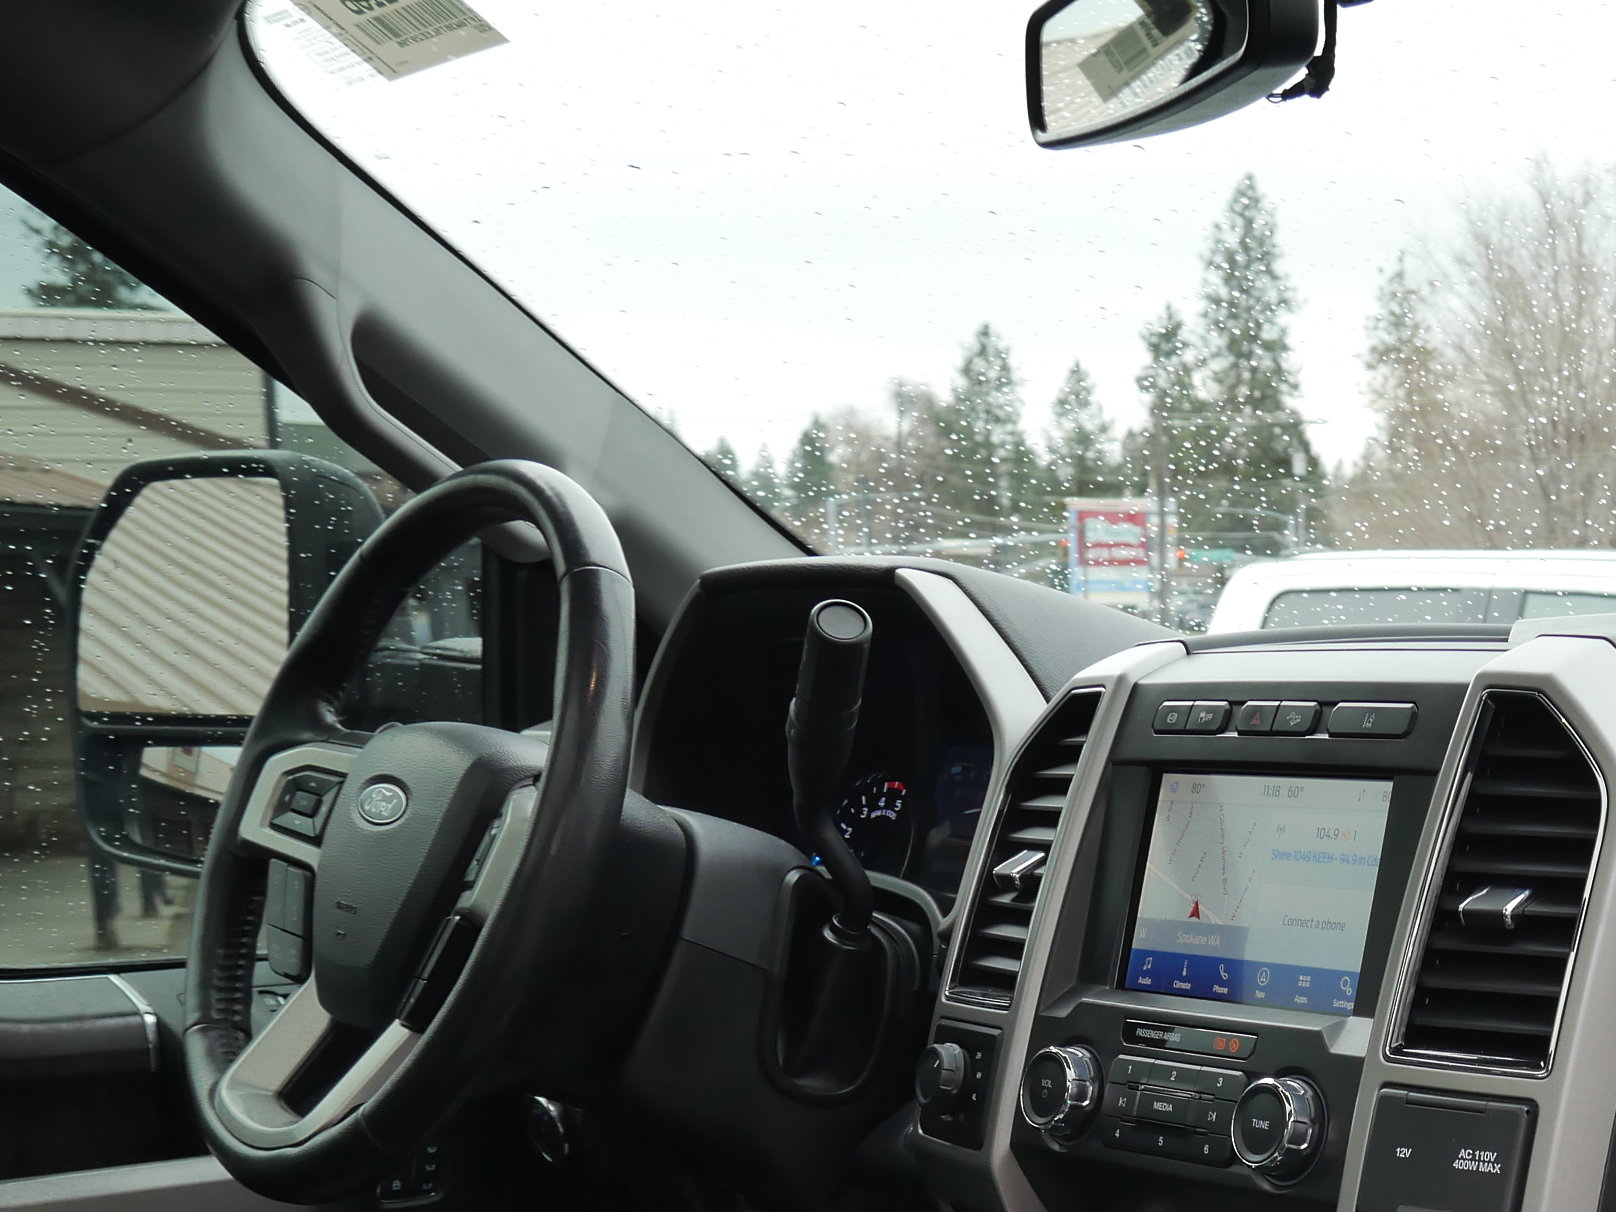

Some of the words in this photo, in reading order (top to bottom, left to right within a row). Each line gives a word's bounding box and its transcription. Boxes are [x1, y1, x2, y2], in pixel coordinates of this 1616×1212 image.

[1262, 784, 1281, 797] 11:18
[363, 787, 397, 817] Ford
[878, 796, 886, 807] 4
[894, 799, 903, 811] 5
[860, 807, 869, 818] 3
[843, 827, 853, 838] 2
[1316, 827, 1340, 840] 104.9
[1271, 848, 1292, 861] Shine
[1282, 914, 1313, 929] Connect
[1321, 919, 1346, 932] phone
[1176, 931, 1206, 946] Spokane
[1206, 934, 1221, 947] WA
[1137, 976, 1152, 985] Audio
[1172, 980, 1191, 990] Climate
[1212, 984, 1229, 995] Phone
[1294, 994, 1308, 1005] Apps
[1135, 1027, 1163, 1040] PASSENGER
[1163, 1031, 1181, 1043] AIRBAG
[1170, 1070, 1177, 1081] 2
[1041, 1078, 1052, 1088] VOL
[1216, 1076, 1223, 1087] 3
[1152, 1101, 1173, 1113] MEDIA
[1251, 1118, 1270, 1130] TUNE
[1203, 1144, 1209, 1154] 6
[1395, 1147, 1412, 1158] 12V
[1458, 1148, 1473, 1160] AC
[1474, 1150, 1498, 1162] 110V
[1452, 1159, 1479, 1172] 400W
[1479, 1161, 1501, 1174] MAX
